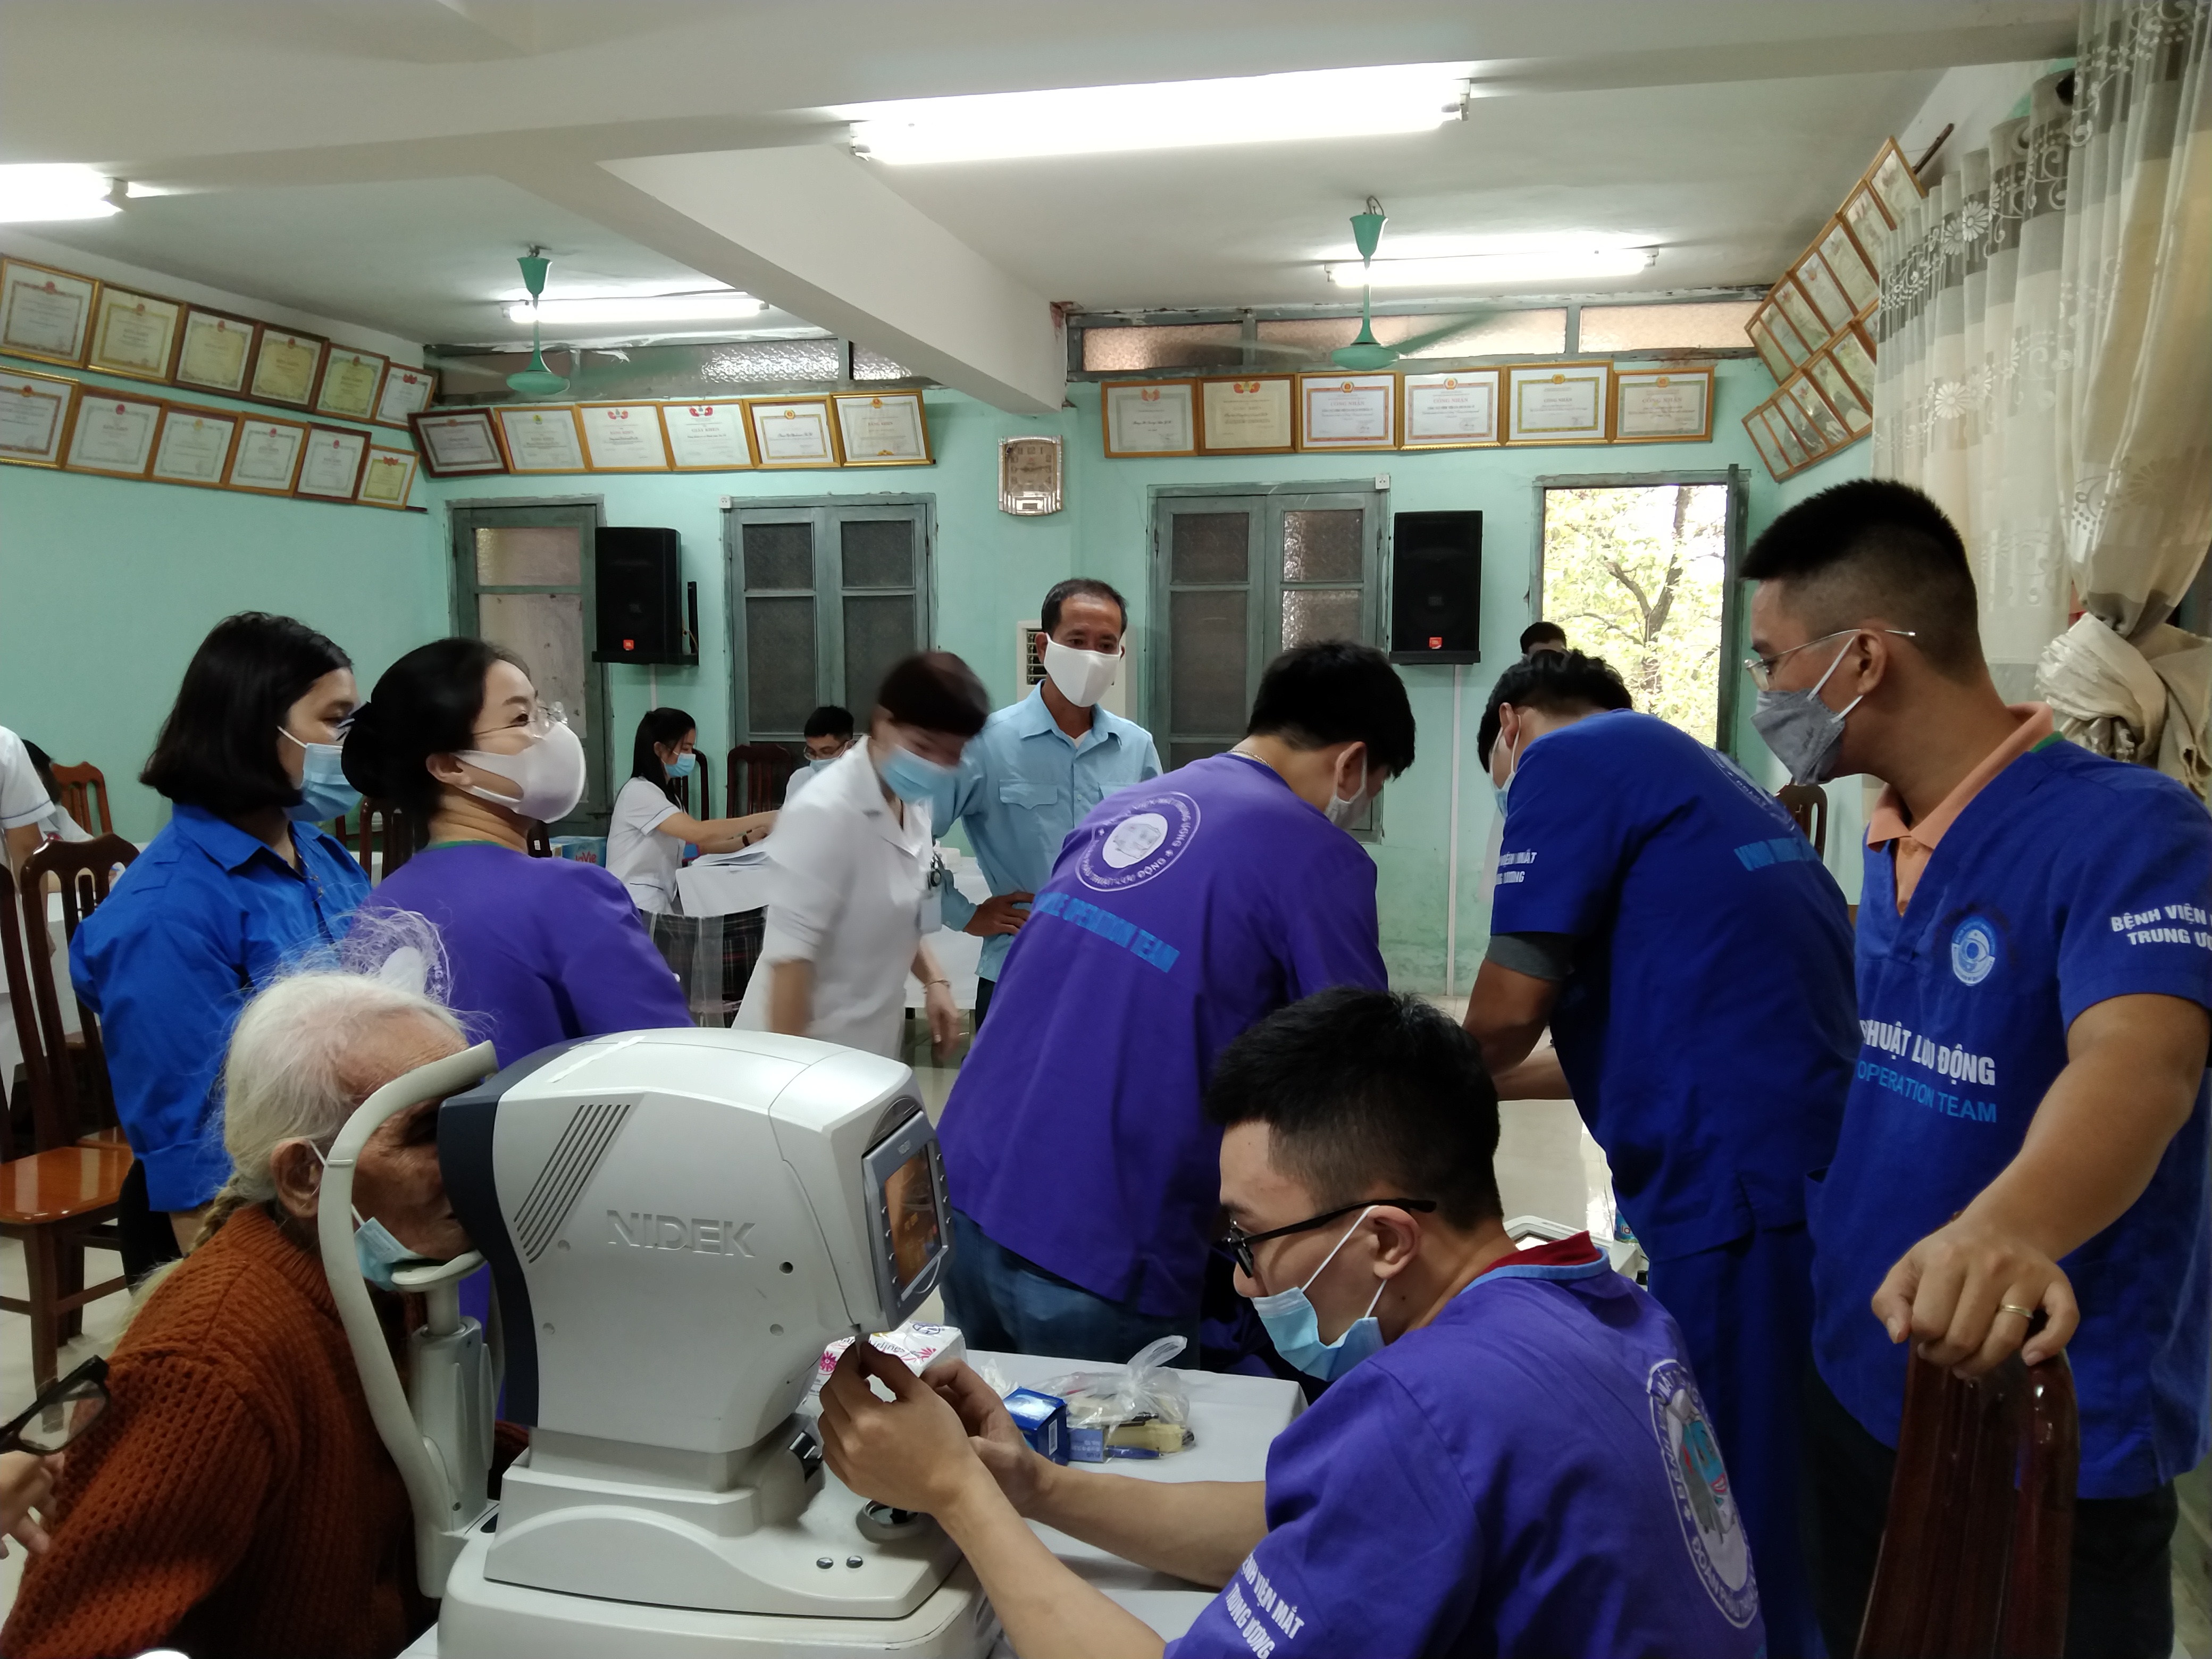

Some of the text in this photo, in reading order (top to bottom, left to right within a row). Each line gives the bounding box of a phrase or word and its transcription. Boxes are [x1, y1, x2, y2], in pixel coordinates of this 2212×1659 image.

[2110, 912, 2161, 932] BỆNH
[2164, 903, 2207, 925] VIỆN
[2127, 928, 2191, 945] TRUNG
[1938, 1043, 1996, 1086] ĐỘNG
[1857, 1060, 1997, 1124] OPERATION TEAM
[606, 1209, 756, 1258] NIDEK
[1271, 1598, 1305, 1640] MẮT
